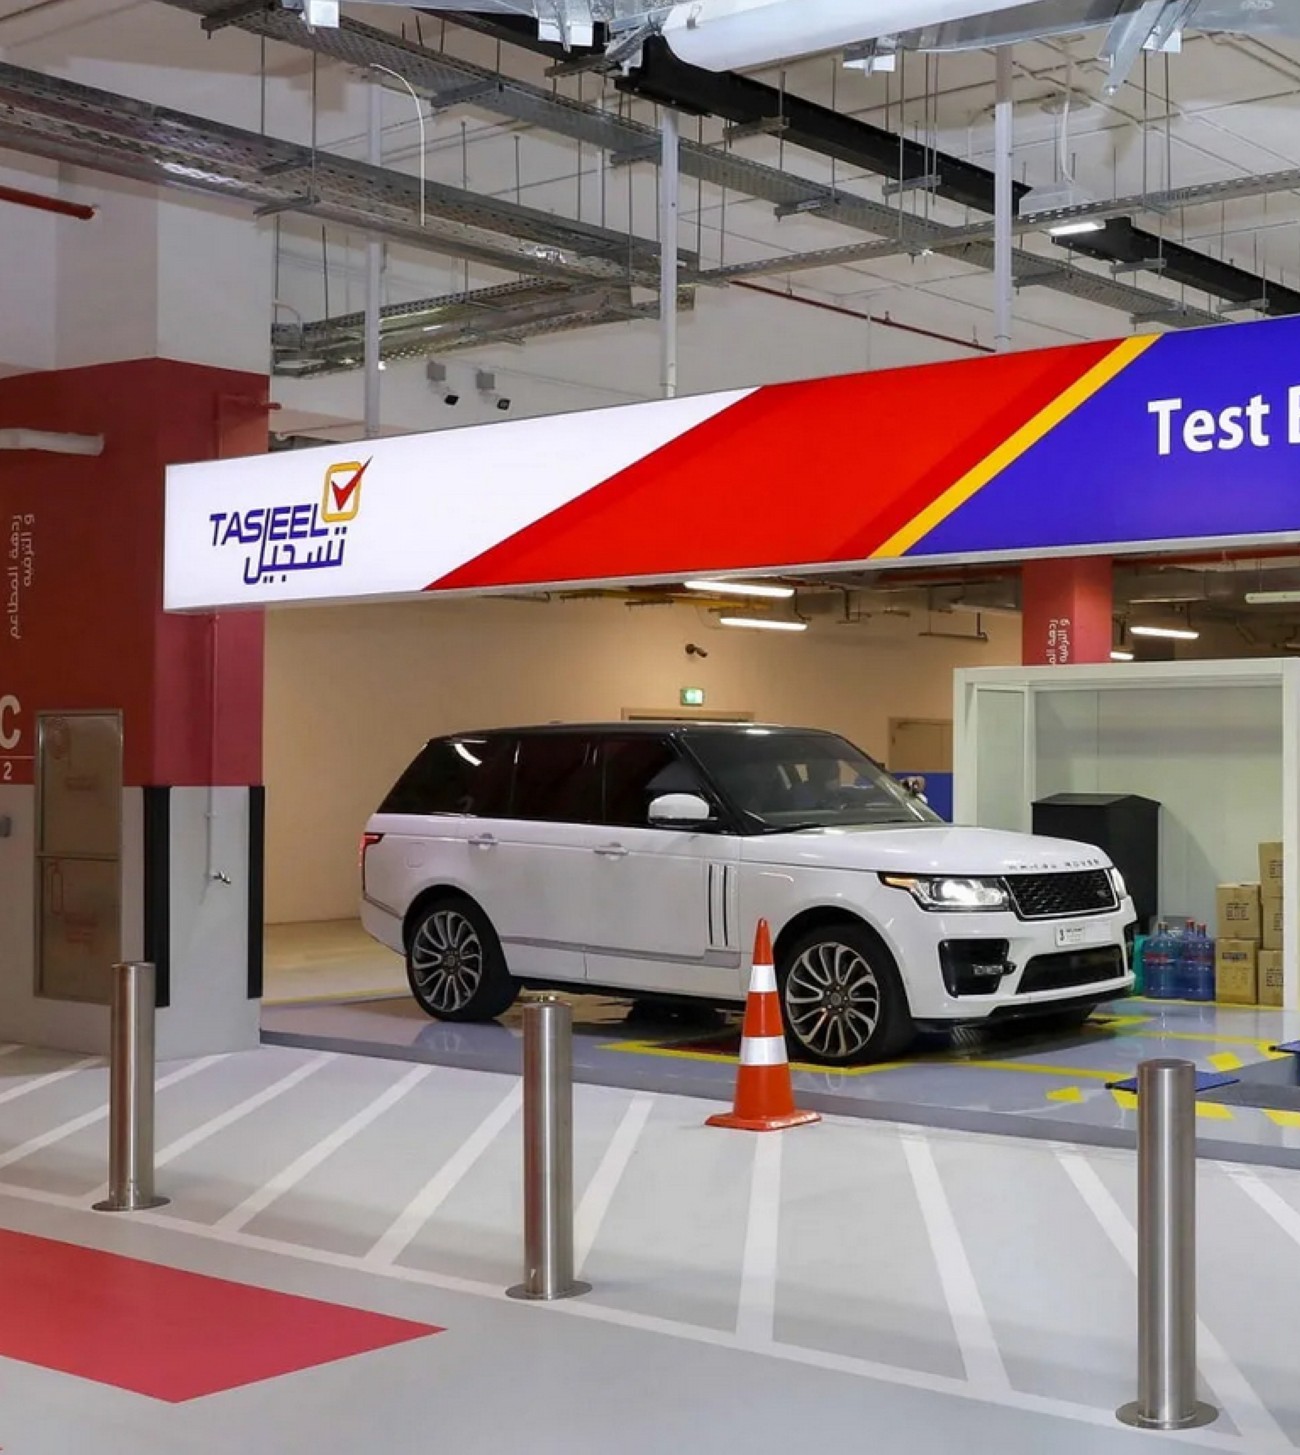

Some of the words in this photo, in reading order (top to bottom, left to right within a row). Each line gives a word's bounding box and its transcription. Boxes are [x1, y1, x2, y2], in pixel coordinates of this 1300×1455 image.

[1147, 396, 1271, 456] Test
[209, 502, 330, 547] TASJEEL
[242, 524, 348, 586] تسجيل
[0, 694, 22, 750] C
[3, 760, 13, 780] 2
